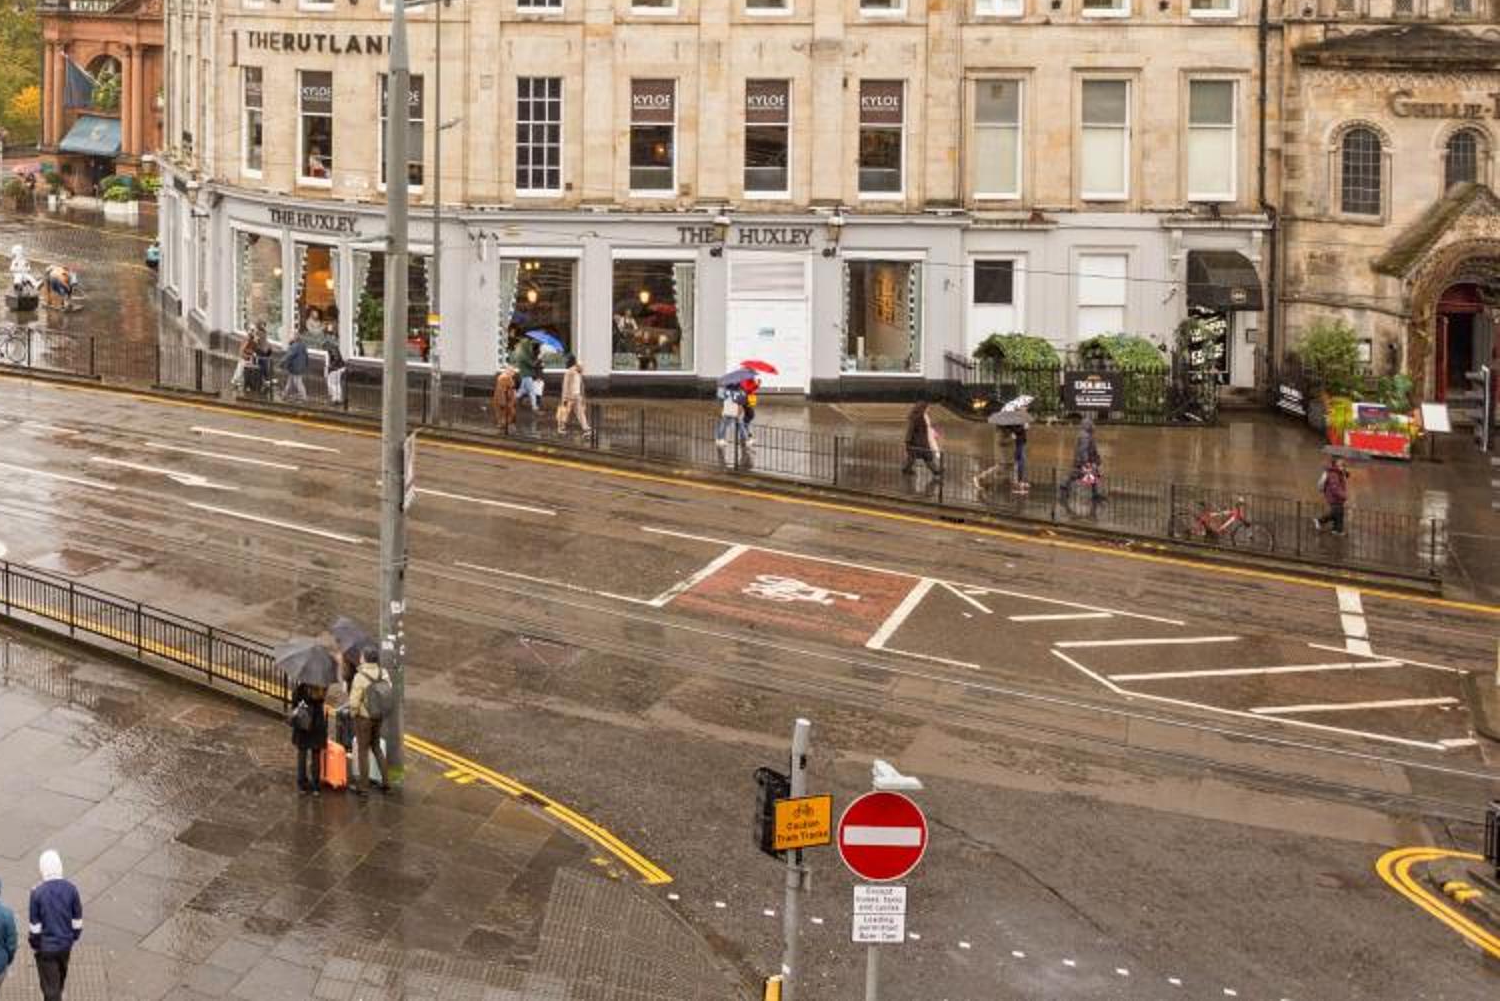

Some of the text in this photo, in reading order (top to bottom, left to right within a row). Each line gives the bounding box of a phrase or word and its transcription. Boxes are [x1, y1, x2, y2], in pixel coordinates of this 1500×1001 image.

[282, 33, 391, 55] RUTLAN
[633, 94, 671, 104] KYLOE
[748, 94, 785, 106] KYLOE
[861, 96, 898, 106] KYLOE
[268, 208, 357, 232] THE HUXLEY
[677, 227, 813, 245] THE HUXLEY
